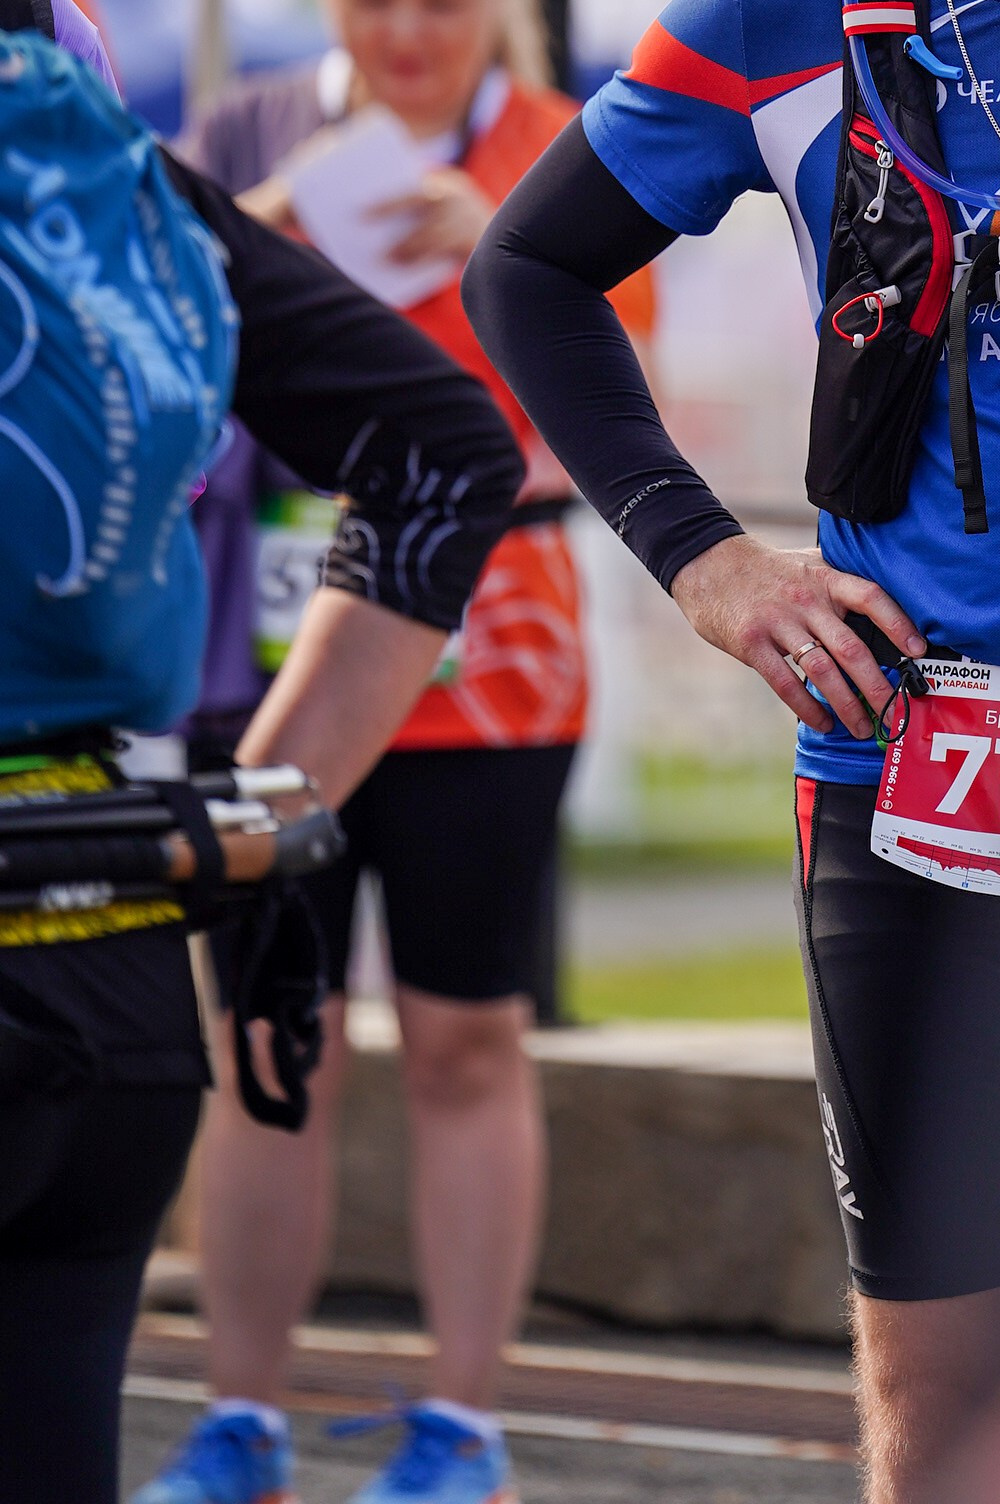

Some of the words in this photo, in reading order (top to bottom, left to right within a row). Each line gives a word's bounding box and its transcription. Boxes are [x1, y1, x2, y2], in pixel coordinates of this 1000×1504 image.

[617, 477, 671, 539] OCKBROS
[921, 664, 991, 680] МАРАФОН
[943, 679, 989, 691] КАРАБАШ
[892, 747, 903, 764] 691
[887, 765, 899, 785] 996
